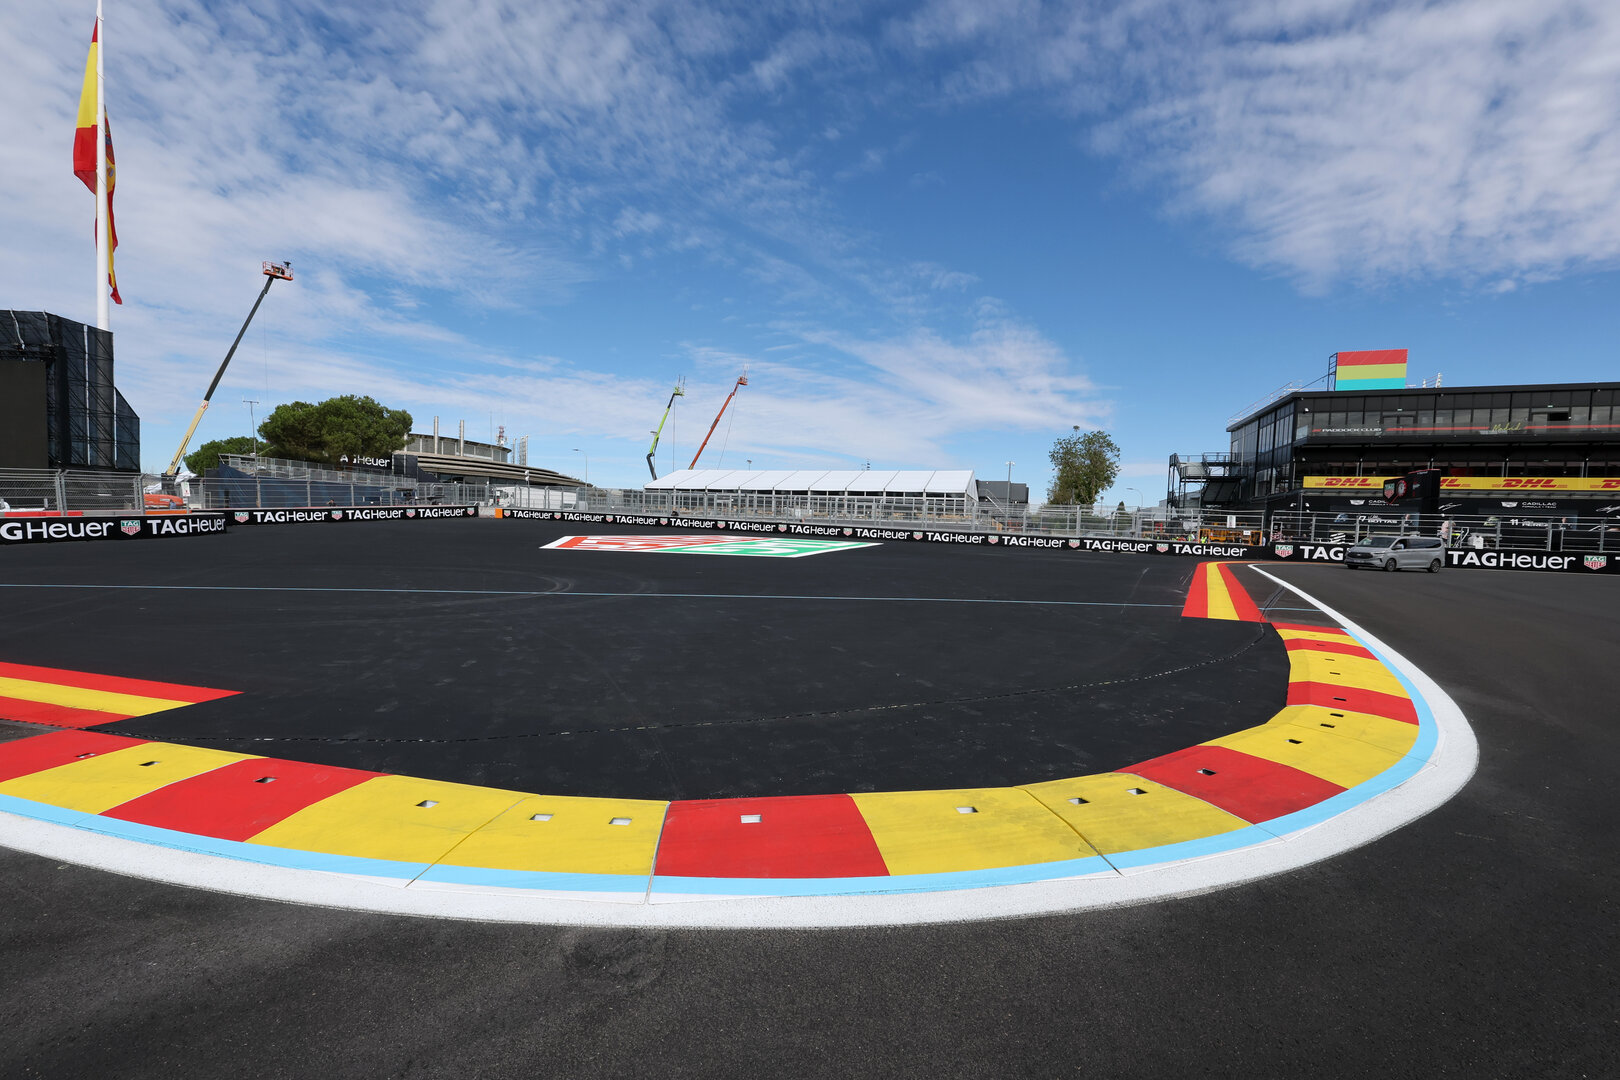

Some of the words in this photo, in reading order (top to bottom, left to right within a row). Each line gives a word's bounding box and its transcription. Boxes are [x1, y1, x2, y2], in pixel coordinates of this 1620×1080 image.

[1324, 478, 1372, 487] DHL
[1502, 478, 1557, 488] DHL
[254, 510, 328, 523] TAGHeuer
[346, 509, 404, 520] TAGHeuer
[418, 507, 465, 518] TAGHeuer
[512, 510, 552, 520] TAGHeuer
[563, 512, 604, 522] TAGHeuer
[615, 515, 658, 525] TAGHeuer
[670, 518, 715, 529] TAGHeuer
[0, 521, 114, 540] GHeuer
[147, 518, 226, 534] TAGHeuer
[728, 521, 776, 532] TAGHeuer
[790, 525, 840, 536] TAGHeuer
[855, 528, 910, 540] TAGHeuer
[926, 532, 985, 544] TAGHeuer
[1002, 536, 1065, 548] TAGHeuer
[1083, 539, 1152, 552] TAGHeuer
[1172, 543, 1247, 557] TAGHeuer
[1447, 551, 1576, 570] TAGHeuer
